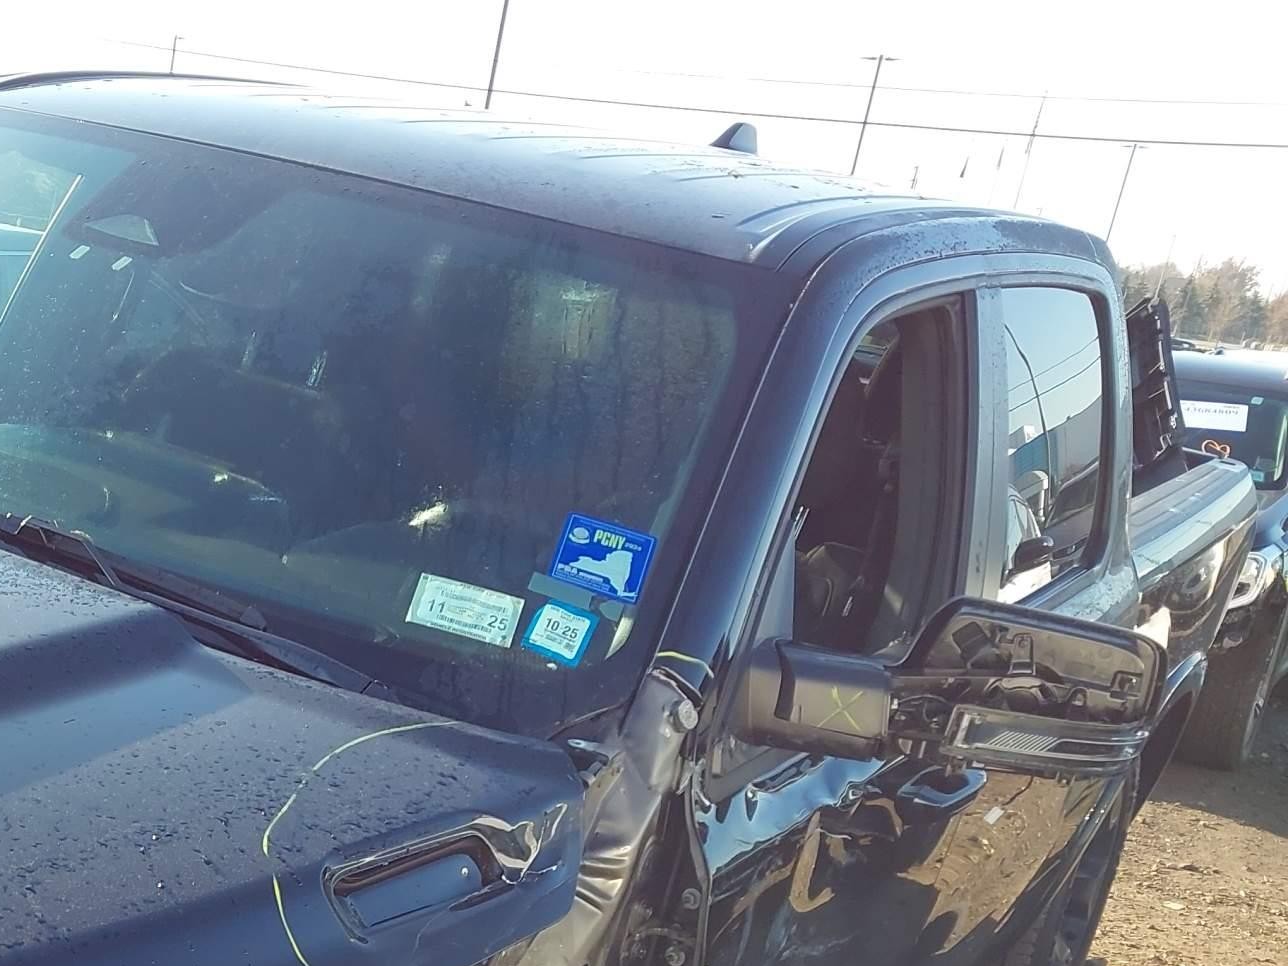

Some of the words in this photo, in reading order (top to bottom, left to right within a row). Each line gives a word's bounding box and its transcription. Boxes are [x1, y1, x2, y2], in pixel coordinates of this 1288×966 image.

[593, 529, 626, 550] PCNY
[428, 599, 446, 613] 11
[487, 615, 509, 631] 25
[546, 617, 561, 631] 10
[562, 625, 580, 640] 25
